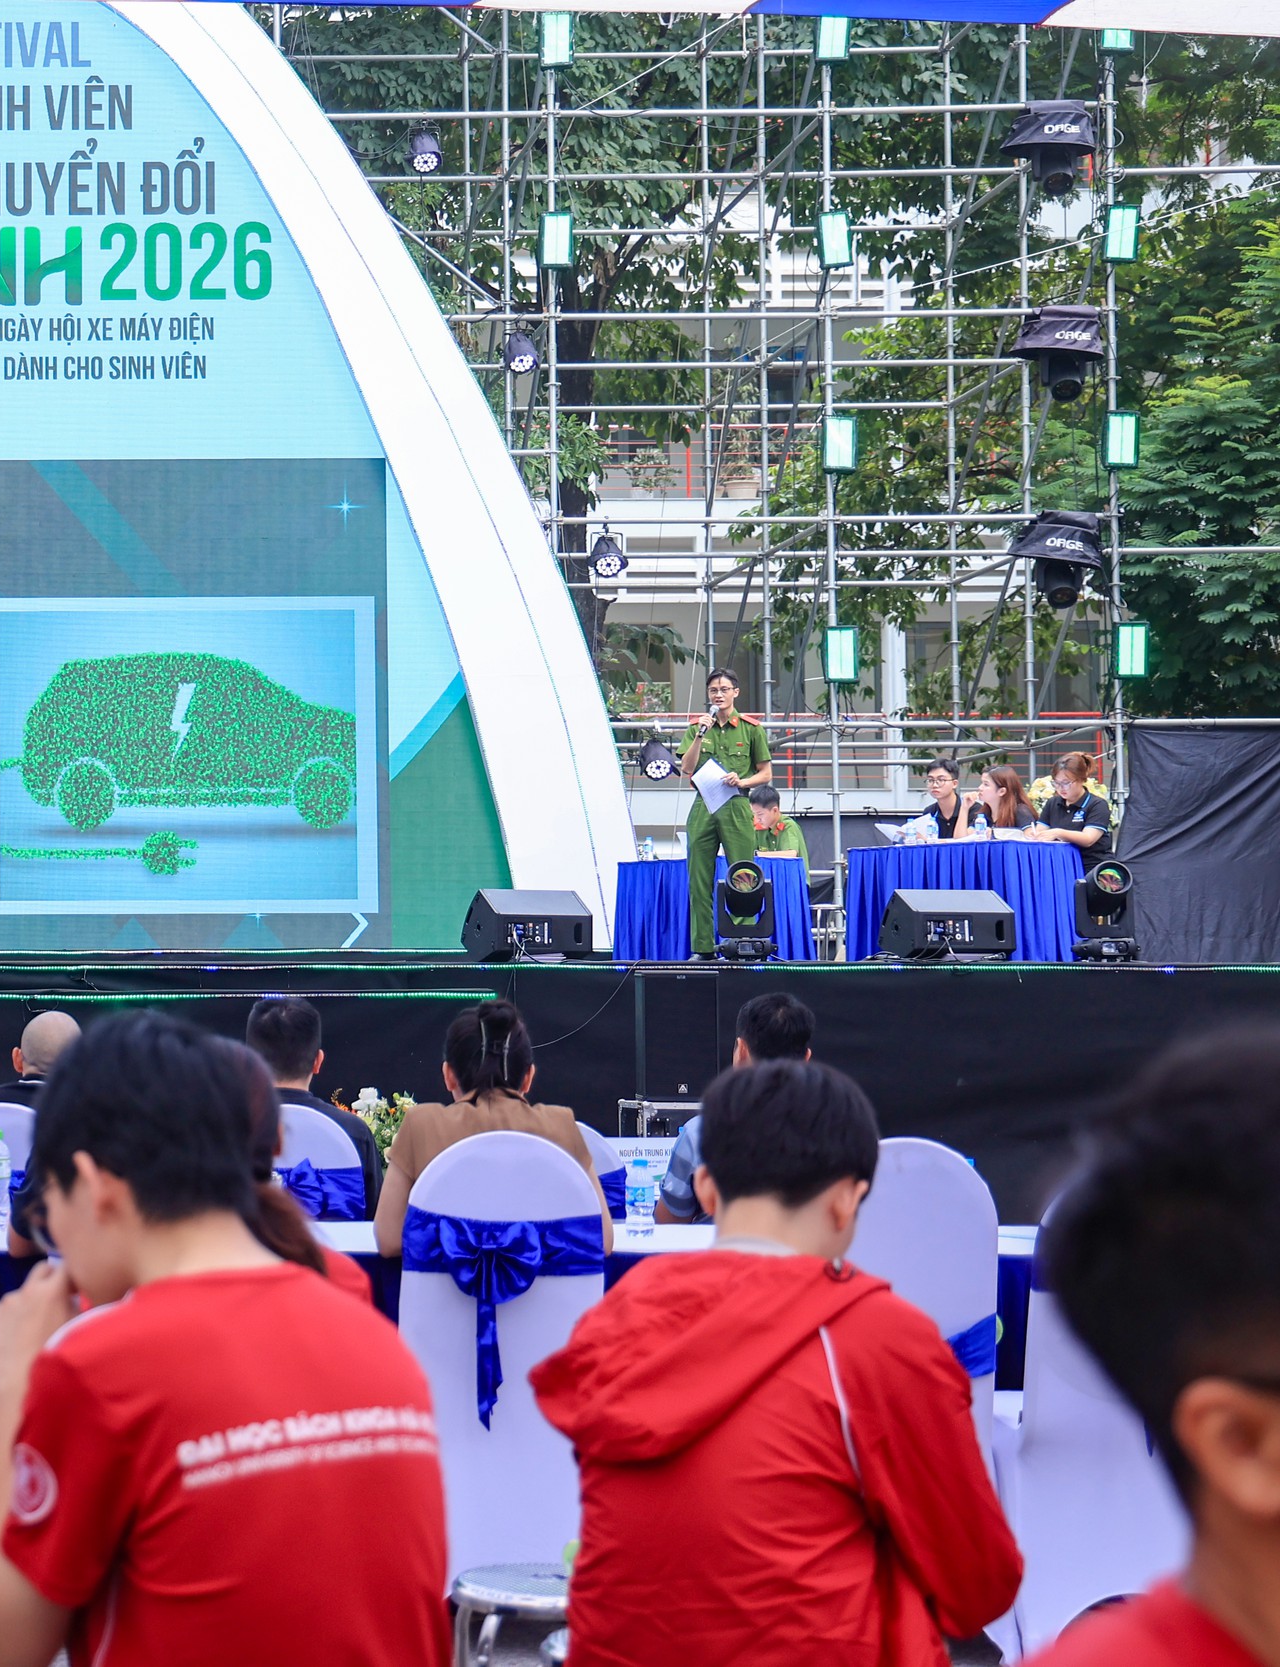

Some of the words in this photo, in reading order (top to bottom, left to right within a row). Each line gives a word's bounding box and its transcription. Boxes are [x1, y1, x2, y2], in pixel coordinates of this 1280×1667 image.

[44, 75, 133, 131] VIÊN
[140, 136, 216, 215] ĐỔI
[99, 222, 272, 301] 2026
[48, 313, 82, 347] HỘI
[87, 318, 114, 341] XE
[119, 312, 163, 341] MÁY
[168, 312, 215, 346] ĐIỆN
[3, 351, 58, 380] DÀNH
[63, 356, 104, 380] CHO
[109, 355, 157, 380] SINH
[162, 350, 207, 379] VIÊN
[644, 1148, 664, 1157] TRUNG
[343, 1405, 397, 1434] KHOA
